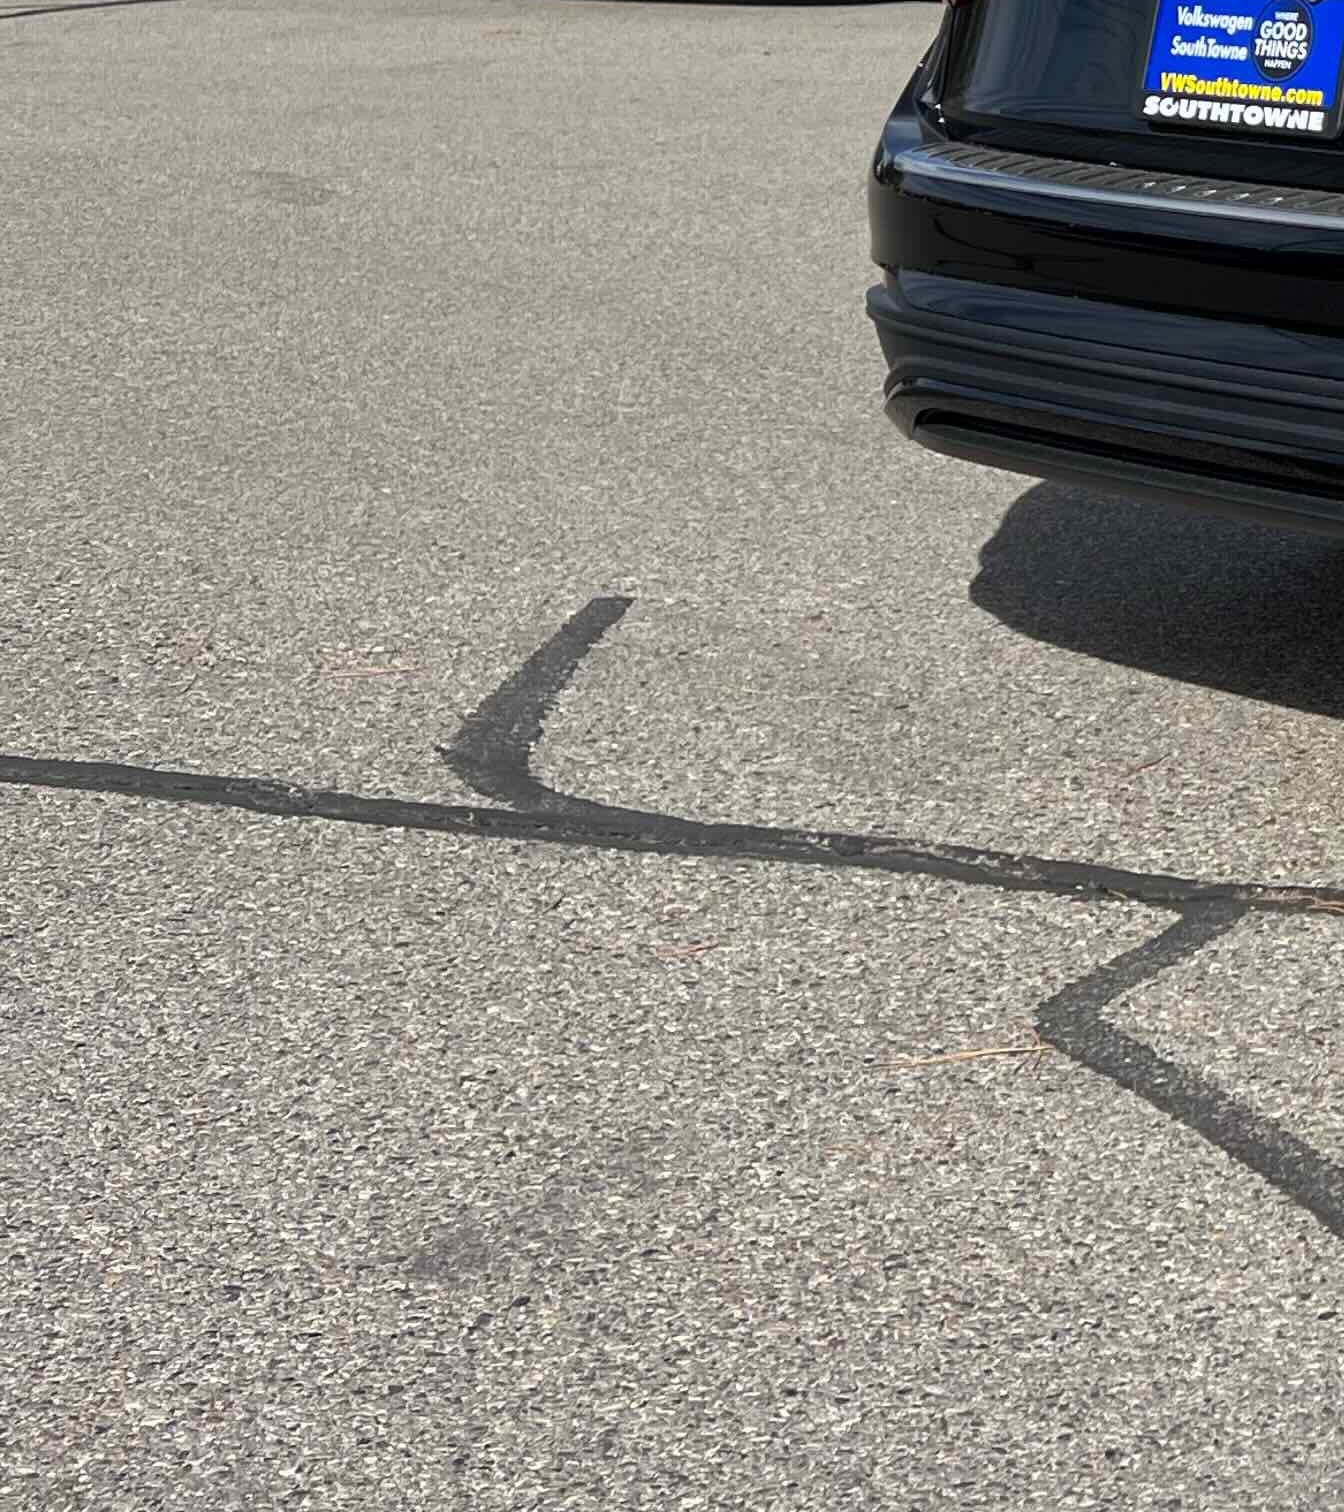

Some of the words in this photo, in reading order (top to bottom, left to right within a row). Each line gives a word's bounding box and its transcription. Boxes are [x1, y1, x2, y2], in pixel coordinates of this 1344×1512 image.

[1177, 5, 1254, 35] Volkswagen
[1260, 20, 1307, 41] GOOD
[1254, 38, 1308, 60] THINGS
[1161, 72, 1323, 105] VWSouthtowne.com
[1143, 95, 1325, 131] SOUTHTOWNE
